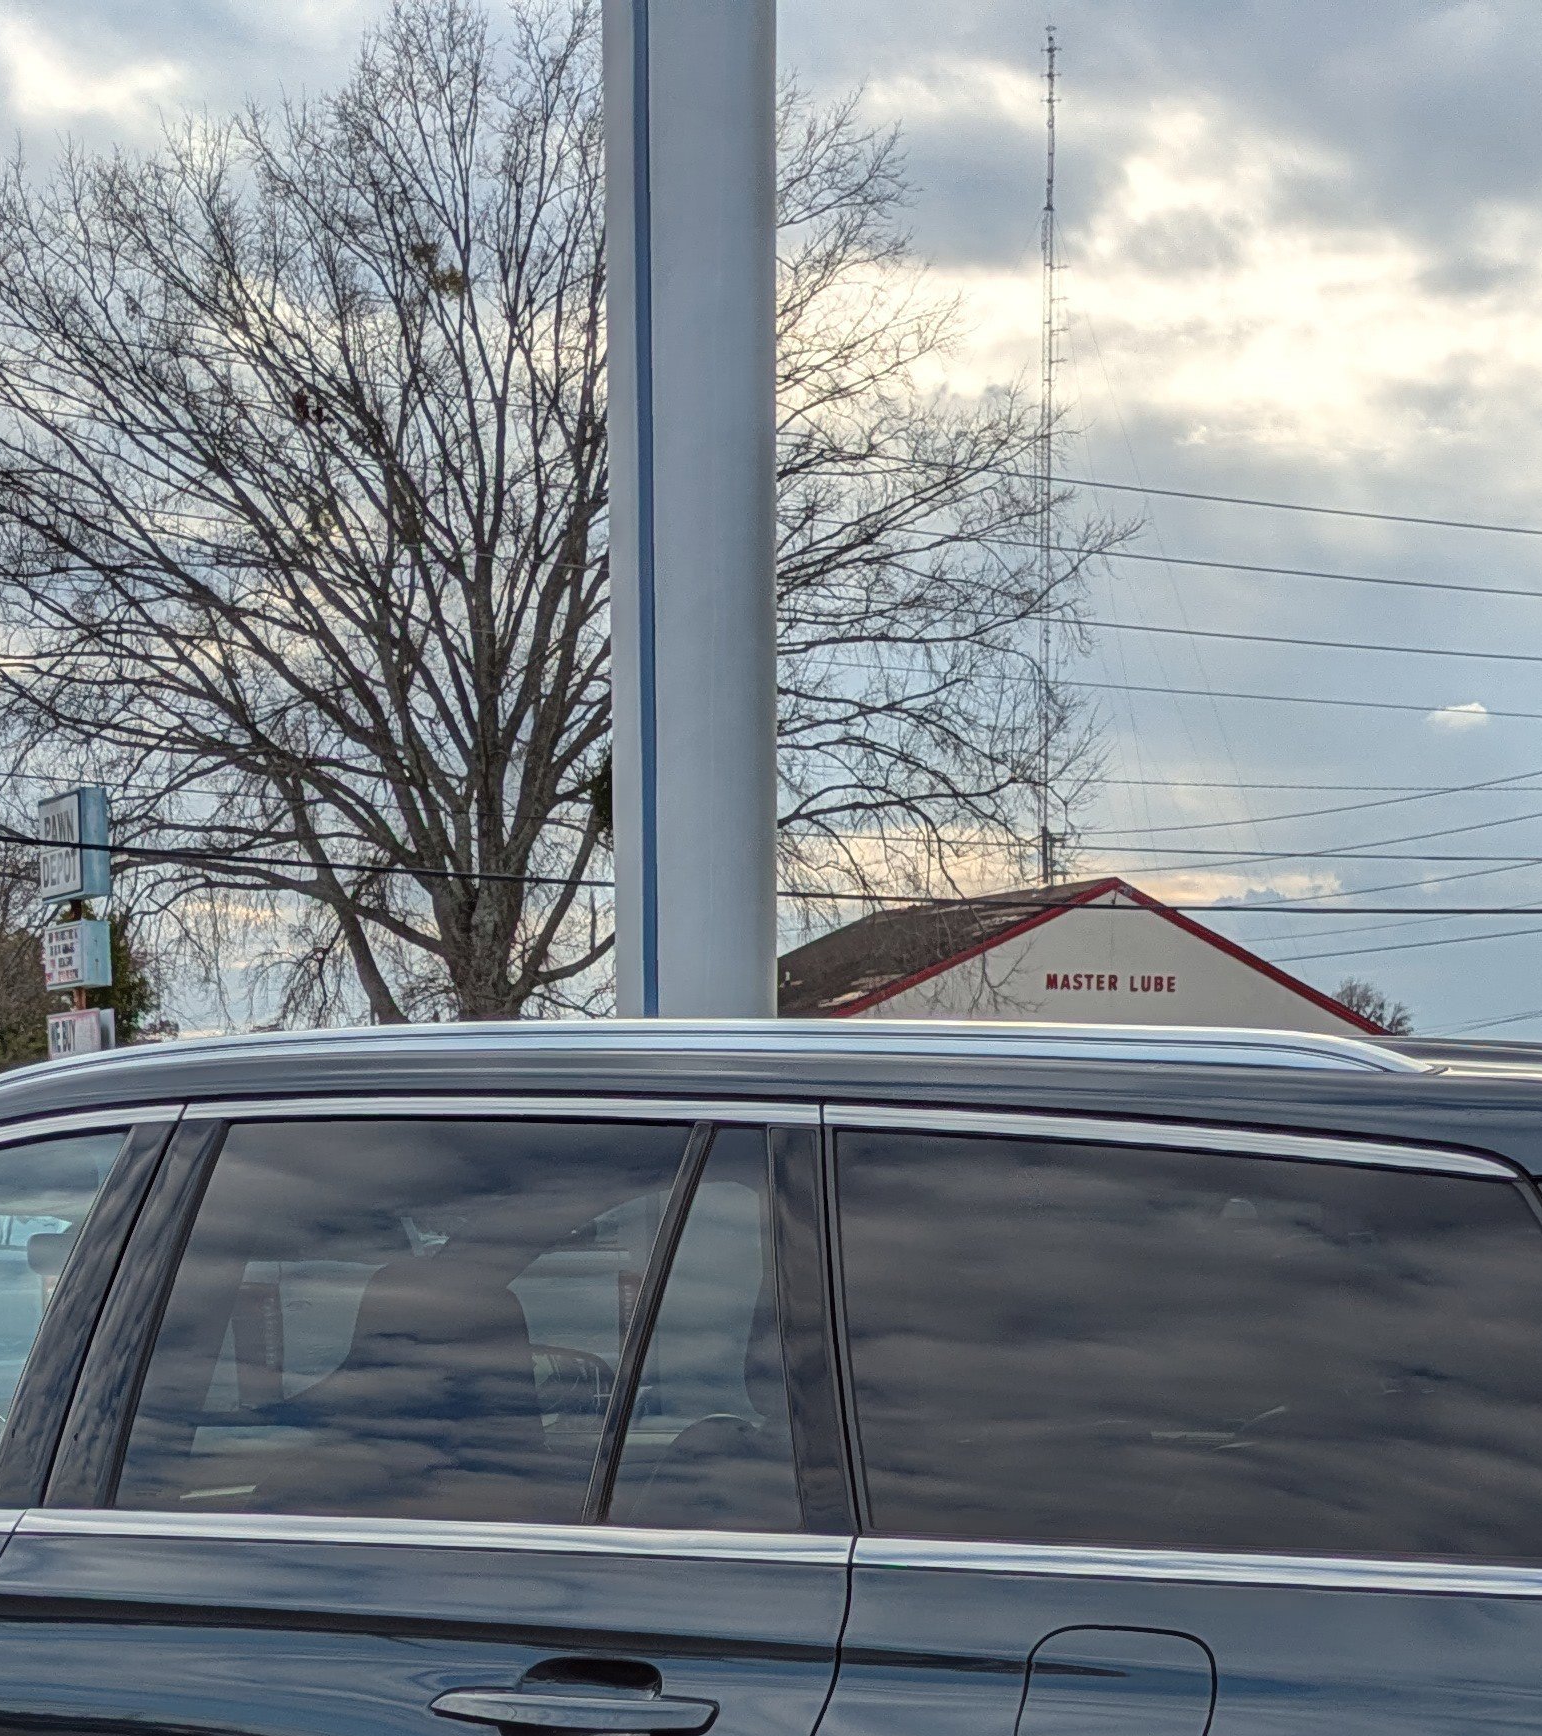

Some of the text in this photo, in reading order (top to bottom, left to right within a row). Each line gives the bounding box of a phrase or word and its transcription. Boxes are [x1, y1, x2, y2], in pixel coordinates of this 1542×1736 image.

[44, 809, 74, 841] PAWN
[42, 848, 77, 888] DEPOT
[1046, 973, 1176, 993] MASTER LUBE
